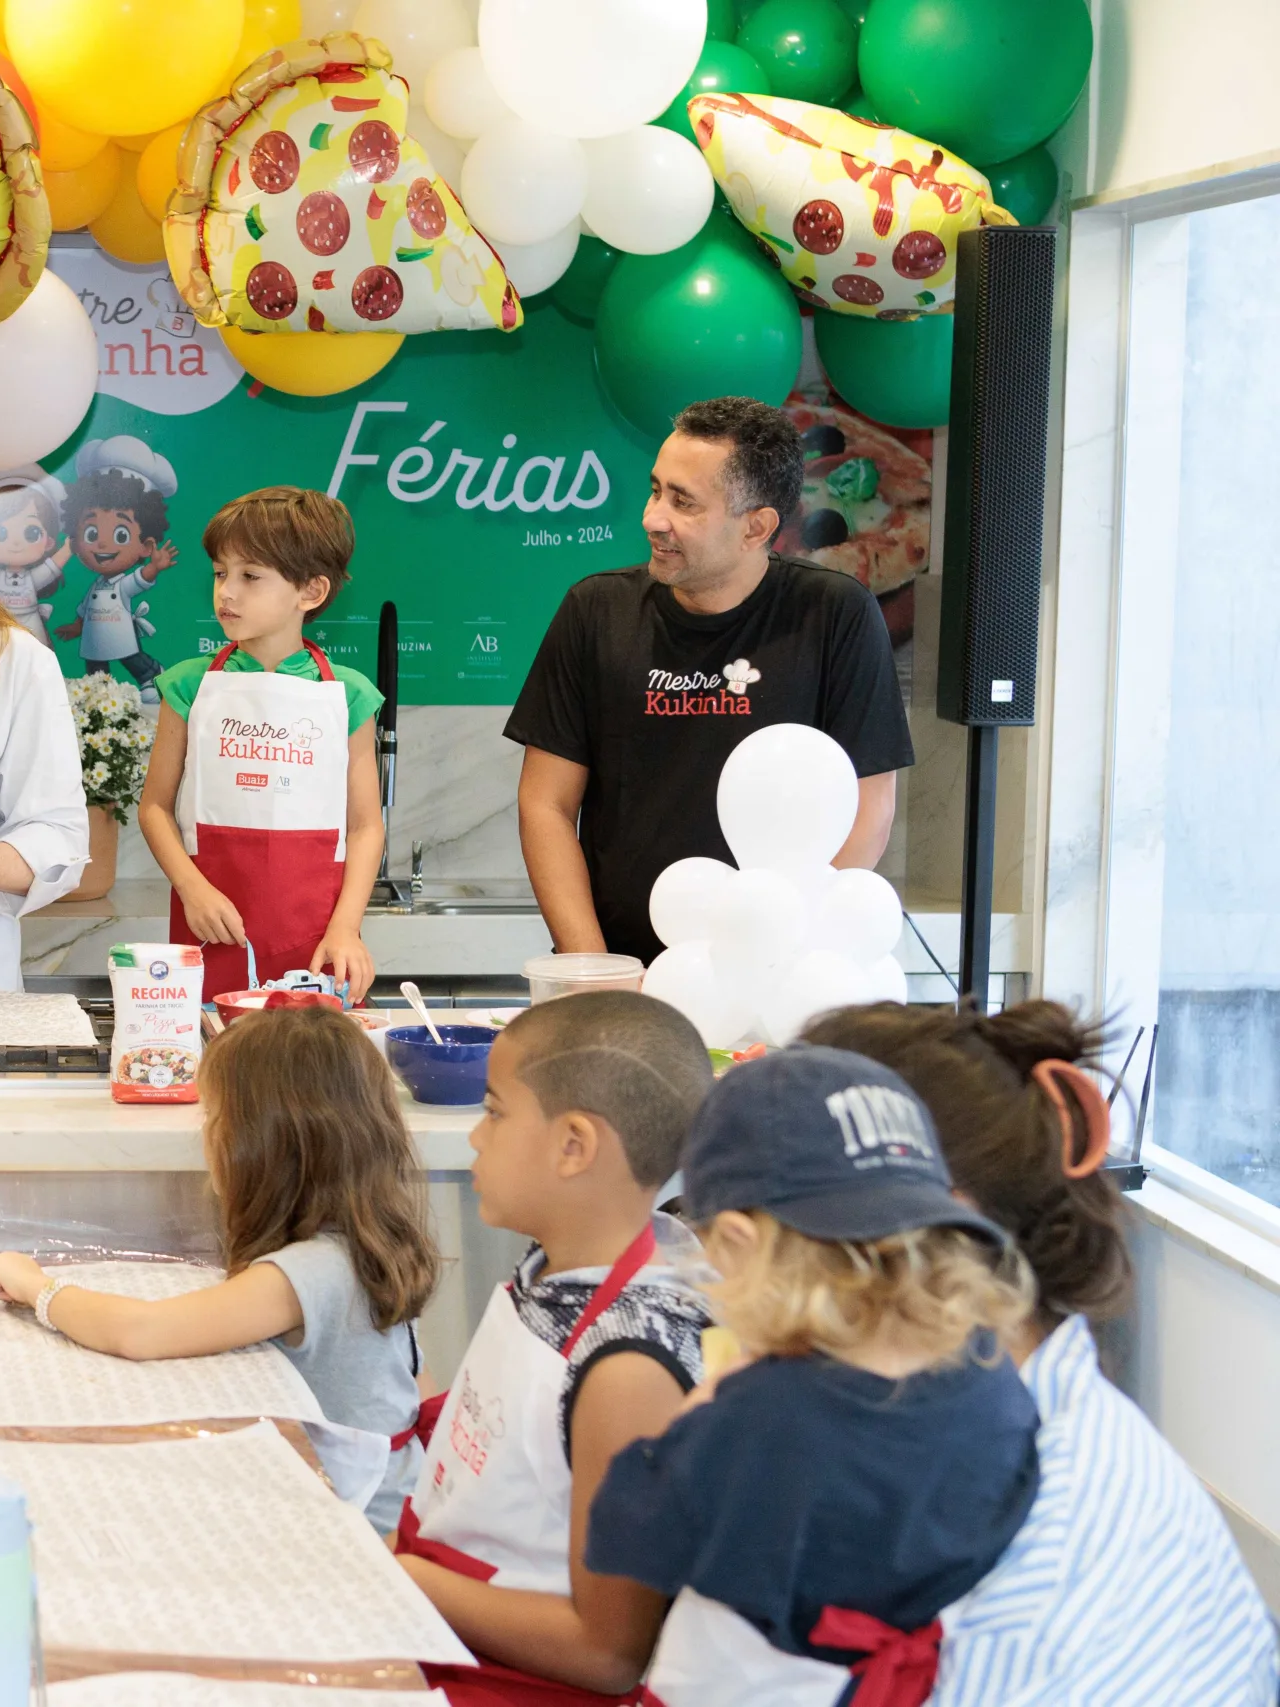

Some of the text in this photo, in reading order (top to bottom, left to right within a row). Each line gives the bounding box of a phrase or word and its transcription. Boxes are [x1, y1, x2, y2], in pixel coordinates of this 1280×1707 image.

[326, 401, 611, 512] Férias
[522, 525, 613, 547] Julho 2024
[470, 633, 498, 653] AB
[648, 669, 721, 691] Mestre
[644, 688, 752, 715] Kukinha
[221, 718, 289, 740] Mestre
[219, 737, 314, 766] Kukinha
[131, 987, 188, 1000] REGINA
